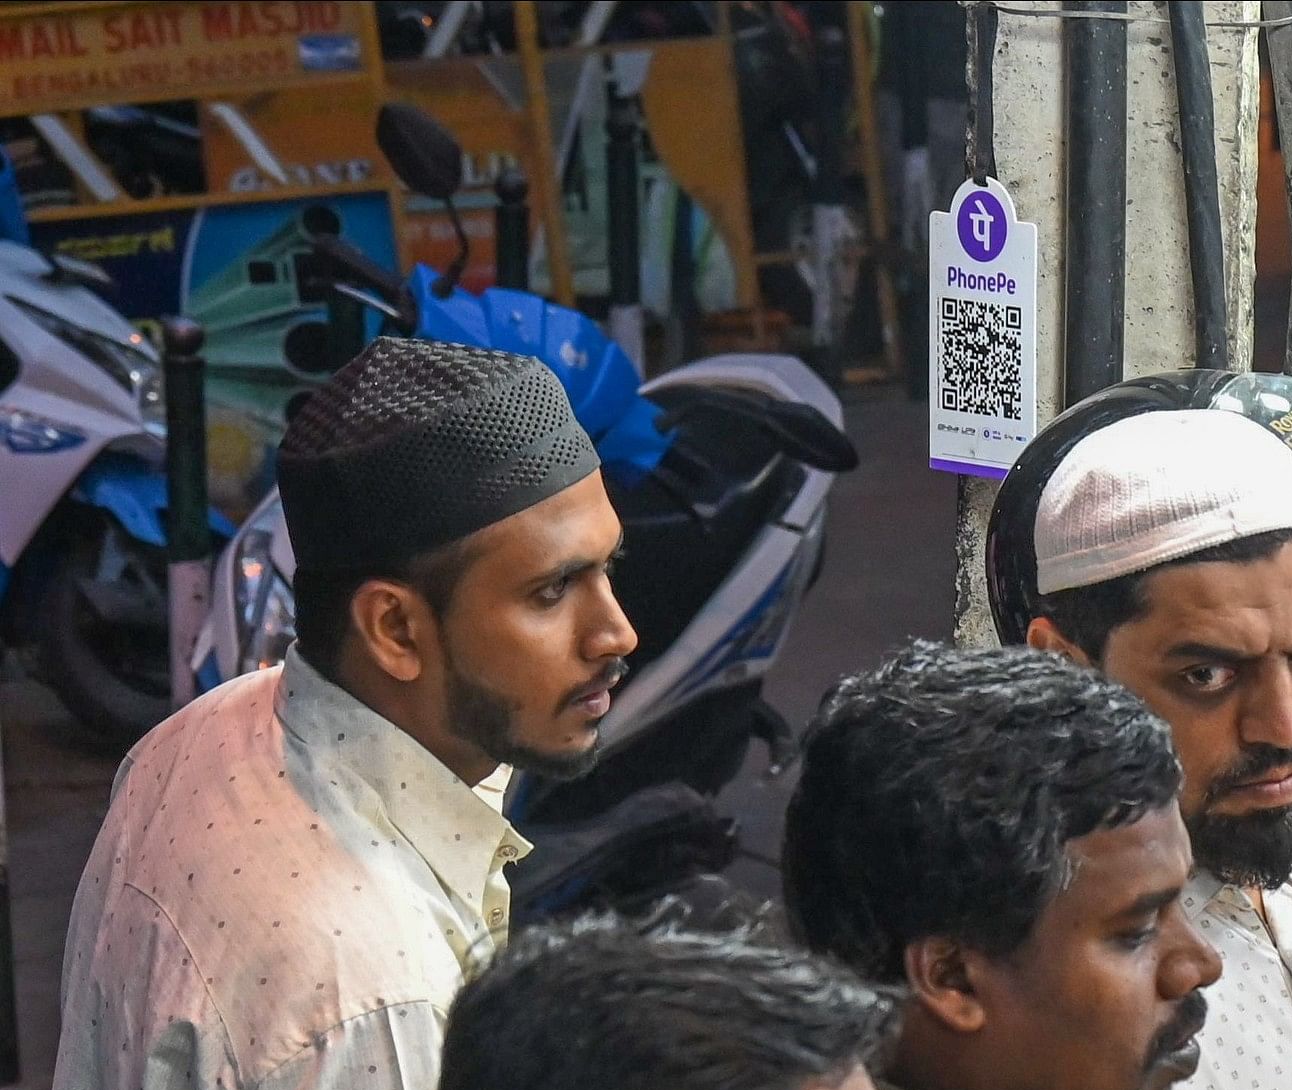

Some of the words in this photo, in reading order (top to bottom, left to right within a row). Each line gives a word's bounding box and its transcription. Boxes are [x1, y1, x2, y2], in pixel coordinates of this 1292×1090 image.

[104, 10, 183, 54] SAIT
[202, 3, 342, 41] MASJID
[969, 199, 994, 251] पे
[947, 266, 1016, 295] PhonePe
